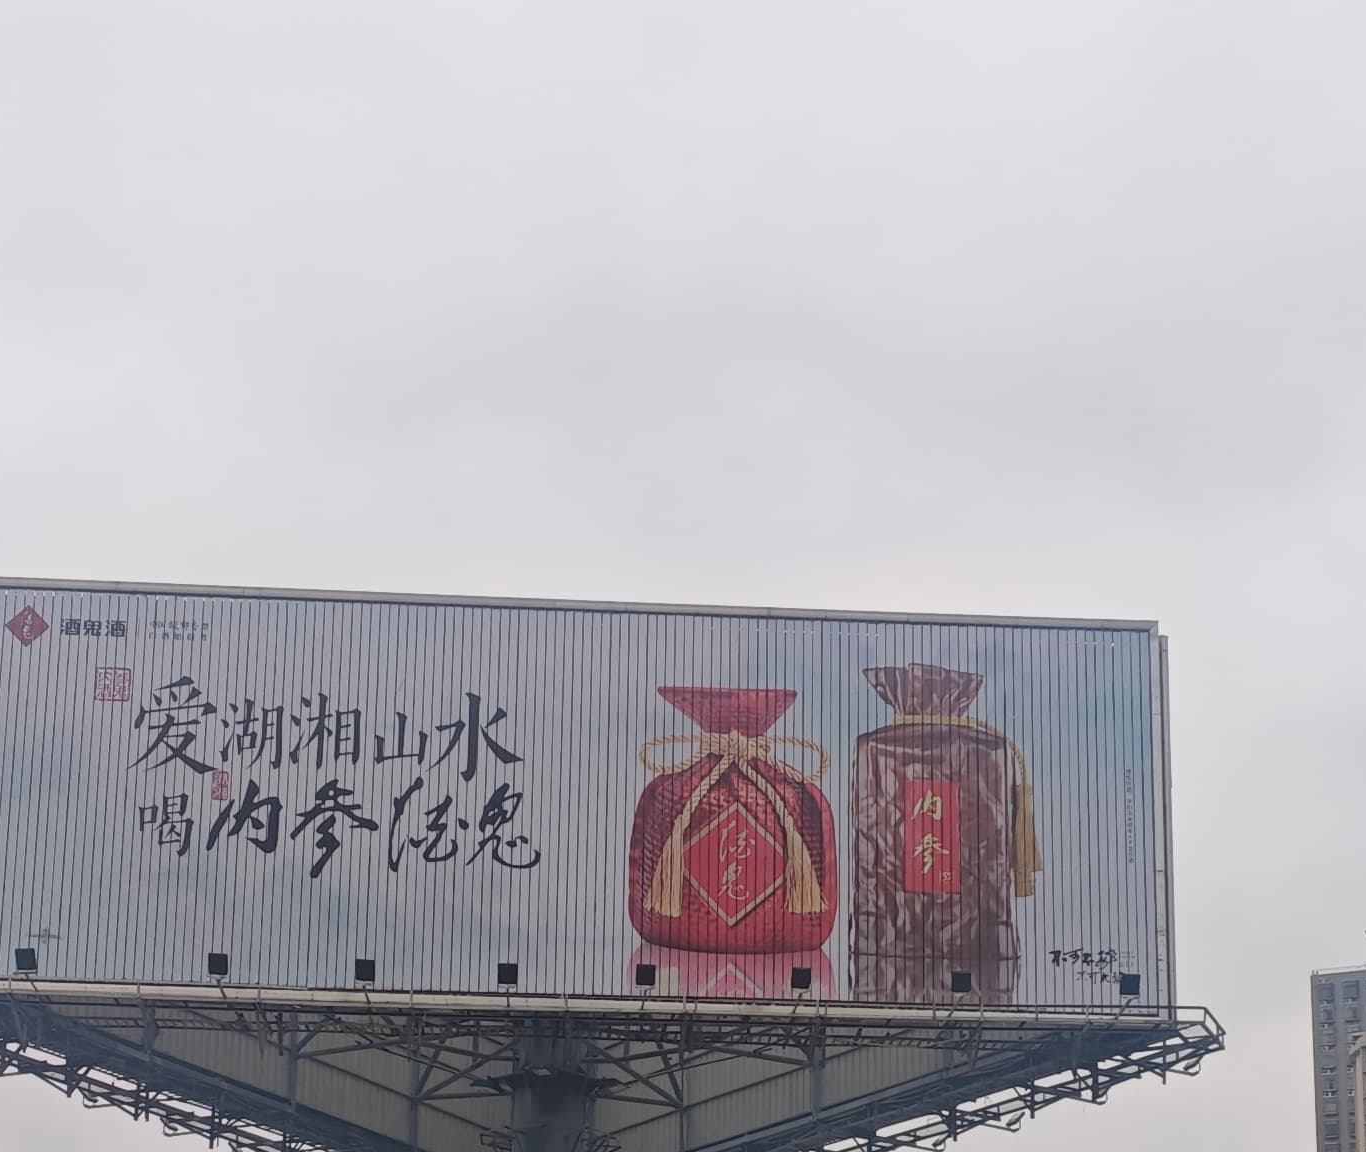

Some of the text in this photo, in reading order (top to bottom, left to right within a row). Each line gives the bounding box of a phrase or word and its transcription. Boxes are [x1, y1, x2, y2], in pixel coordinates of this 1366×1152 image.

[60, 616, 126, 638] 酒鬼酒
[128, 676, 524, 782] 爱湖湘山水
